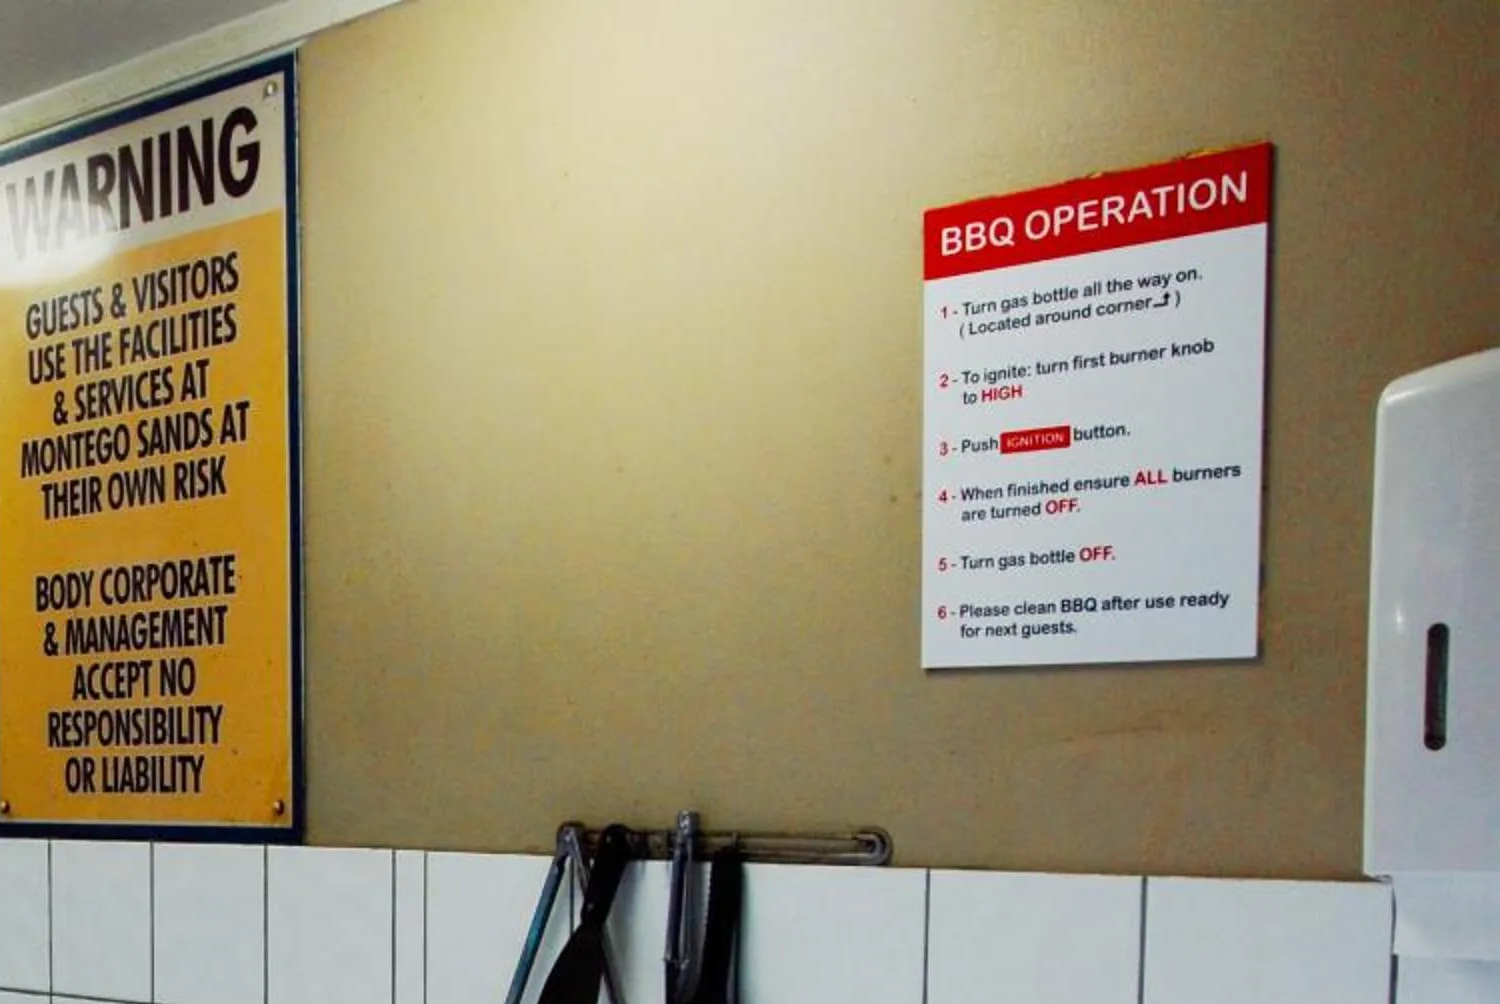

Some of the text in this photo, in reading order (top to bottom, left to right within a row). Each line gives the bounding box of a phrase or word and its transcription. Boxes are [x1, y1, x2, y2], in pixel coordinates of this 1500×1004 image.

[6, 106, 260, 260] WARNING
[941, 170, 1247, 256] BBQ OPERATION
[26, 252, 238, 340] GUESTS & VISITORS
[962, 301, 996, 316] Turn
[1001, 296, 1028, 313] gas
[1033, 286, 1078, 305] bottle
[1083, 281, 1101, 297] all
[1106, 279, 1133, 293] the
[1137, 272, 1172, 288] way
[1035, 305, 1091, 325] around
[1095, 296, 1152, 316] corner
[28, 303, 237, 384] USE THE FACILITIES
[961, 370, 980, 385] To
[984, 365, 1032, 385] ignite:
[1036, 360, 1069, 375] turn
[1073, 353, 1105, 370] first
[1109, 346, 1167, 366] burner
[1171, 338, 1215, 358] knob
[53, 358, 209, 425] & SERVICES AT
[963, 384, 1023, 404] to HIGH
[21, 401, 249, 478] MONTEGO SANDS AT
[961, 437, 999, 453] Push
[1007, 433, 1064, 449] IGNITION
[1073, 424, 1131, 441] button.
[41, 457, 227, 520] THEIR OWN RISK
[961, 485, 1003, 501] When
[1007, 477, 1069, 497] finished
[1073, 475, 1130, 490] ensure
[1134, 469, 1168, 486] ALL
[1172, 464, 1241, 482] burners
[961, 508, 986, 522] are
[991, 502, 1041, 519] turned
[960, 555, 994, 570] Turn
[998, 556, 1026, 571] gas
[1029, 550, 1075, 565] bottle
[36, 555, 236, 612] BODY CORPORATE
[959, 604, 1010, 618] Please
[1013, 600, 1056, 615] clean
[1060, 597, 1097, 613] BBQ
[1101, 595, 1140, 611] after
[1145, 595, 1175, 608] use
[1180, 590, 1230, 609] ready
[44, 606, 228, 656] & MANAGEMENT
[960, 624, 981, 638] for
[985, 622, 1017, 636] next
[72, 658, 195, 701] ACCEPT NO
[48, 705, 223, 748] RESPONSIBILITY
[65, 755, 204, 793] OR LIABILITY
